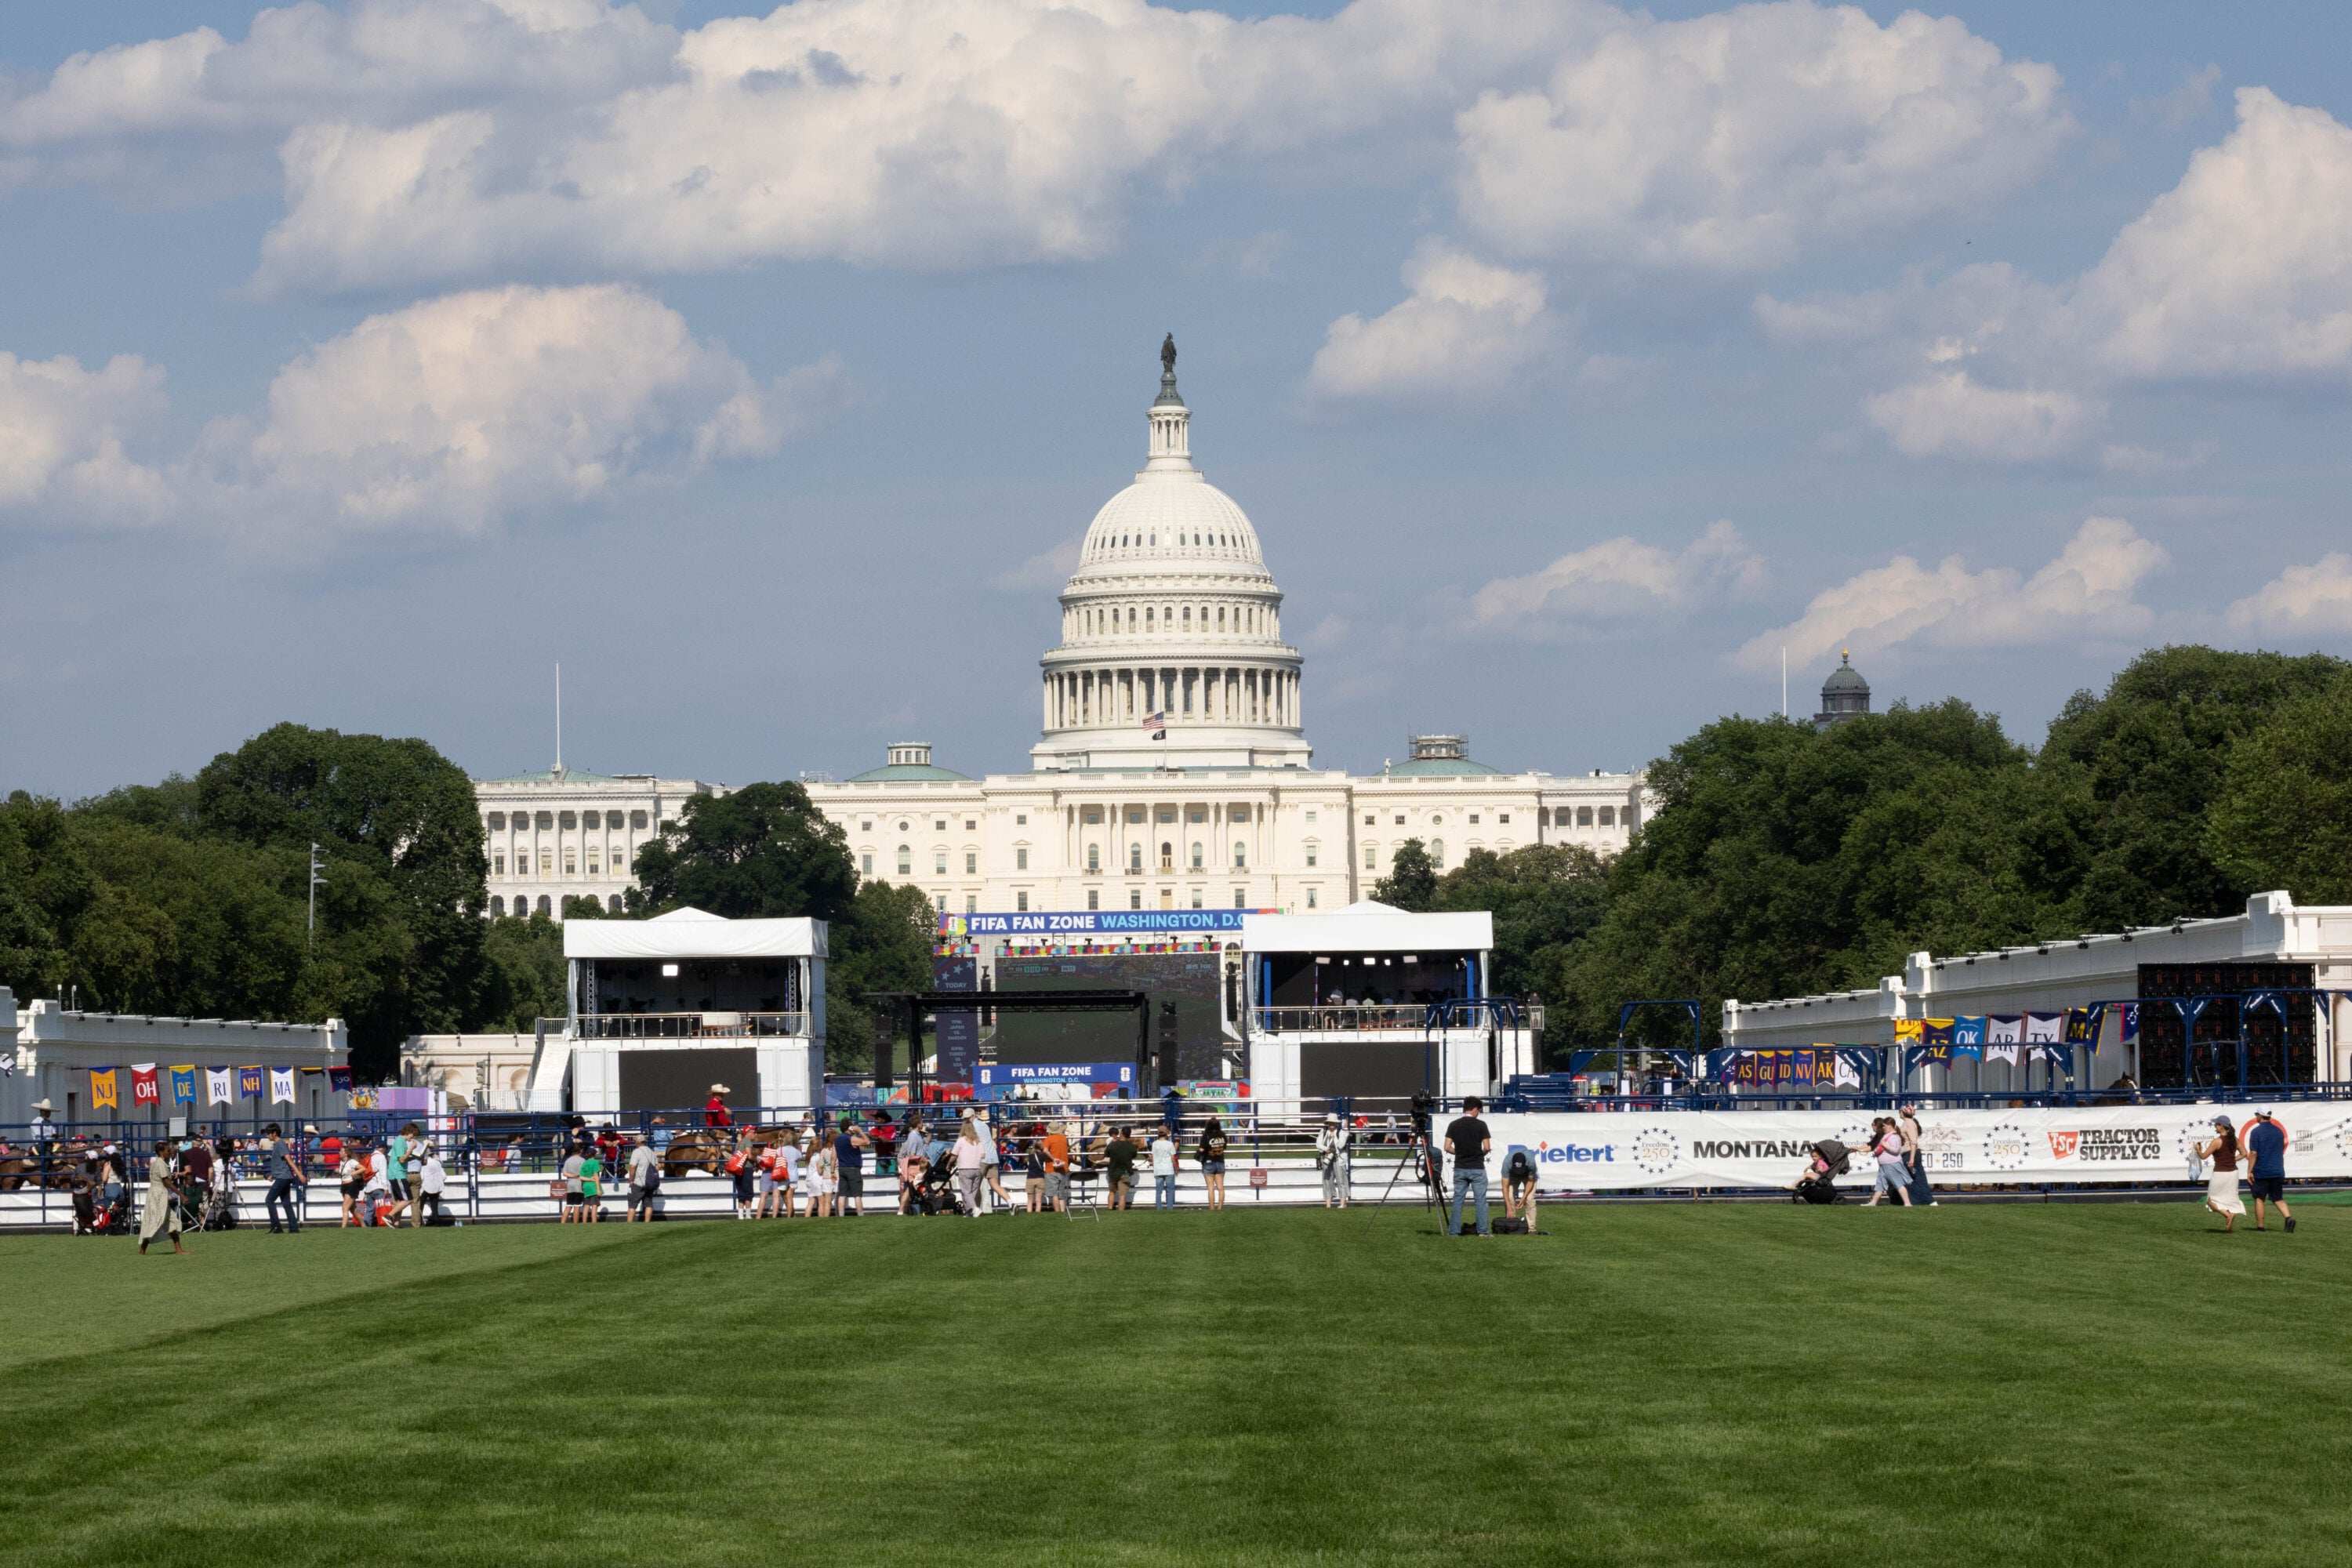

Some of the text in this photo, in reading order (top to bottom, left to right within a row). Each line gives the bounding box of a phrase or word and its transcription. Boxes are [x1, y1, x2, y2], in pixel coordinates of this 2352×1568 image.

[971, 916, 1007, 930] FIFA
[1013, 916, 1044, 930] FAN
[1050, 915, 1094, 929] ZONE
[1102, 914, 1218, 928] WASHINGTON,
[1928, 1039, 1949, 1058] AZ
[1956, 1030, 1978, 1051] OK
[1992, 1033, 2013, 1054] AR
[1011, 1067, 1091, 1077] FIFA FAN ZONE
[1738, 1064, 1752, 1079] AS
[1759, 1065, 1774, 1080] GU
[1780, 1064, 1791, 1078] ID
[1795, 1063, 1813, 1080] NV
[1817, 1062, 1835, 1078] AK
[96, 1083, 113, 1099] NJ
[136, 1080, 157, 1098] OH
[177, 1081, 193, 1097] DE
[214, 1082, 227, 1097] RI
[242, 1077, 260, 1091] NH
[274, 1081, 292, 1096] MA
[2050, 1132, 2074, 1155] TSC
[2079, 1128, 2159, 1145] TRACTOR
[1643, 1148, 1669, 1162] 250
[1693, 1141, 1813, 1159] MONTANA
[1993, 1145, 2020, 1159] 250
[2079, 1145, 2140, 1160] SUPPLY
[1943, 1153, 1962, 1168] 250
